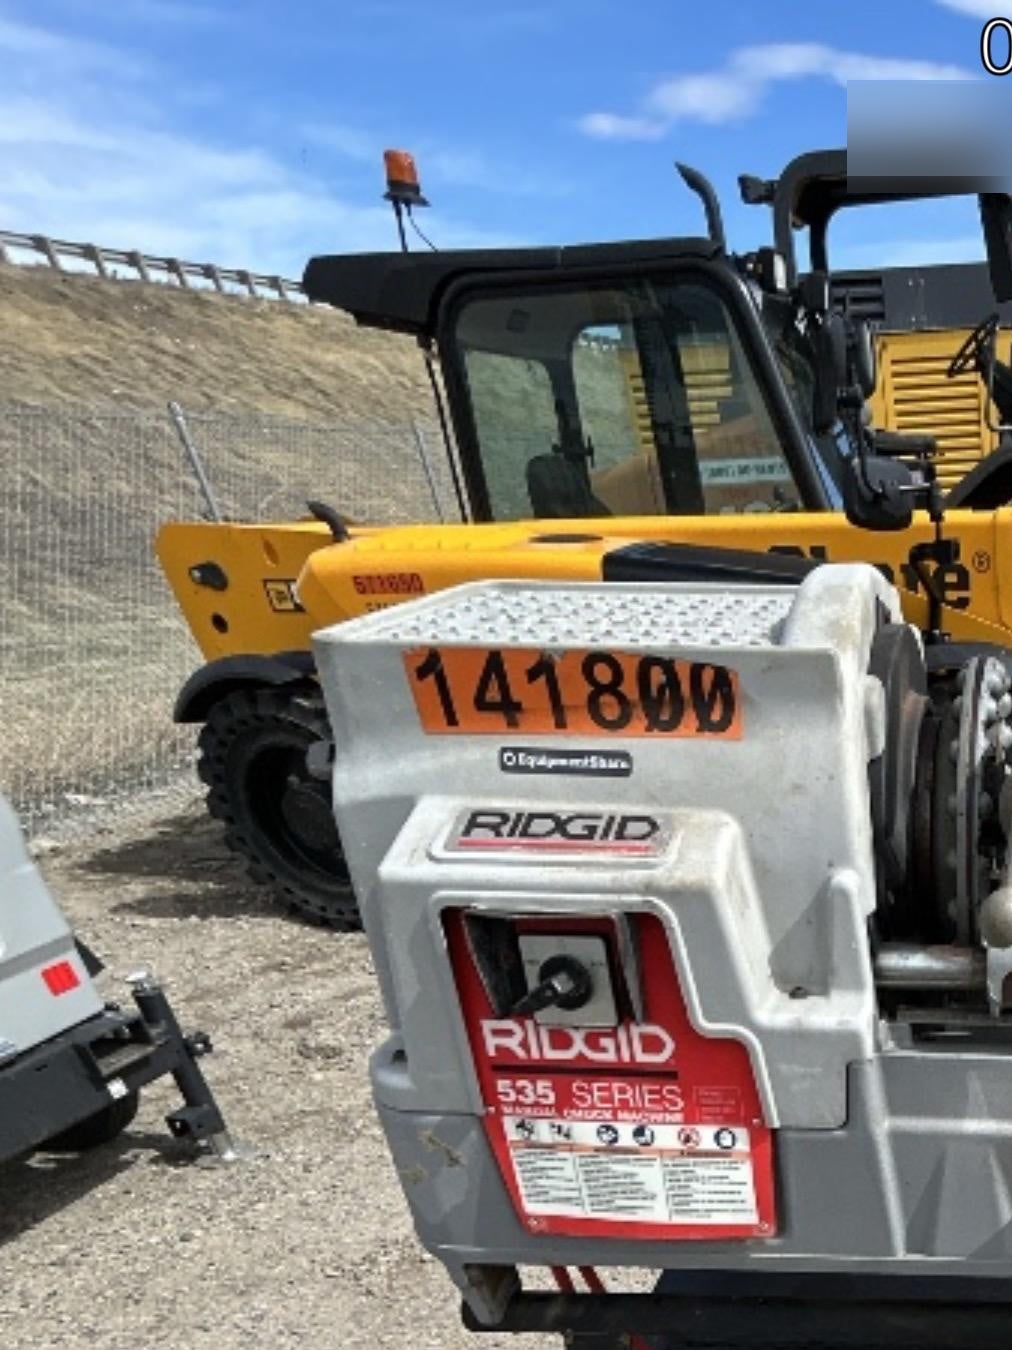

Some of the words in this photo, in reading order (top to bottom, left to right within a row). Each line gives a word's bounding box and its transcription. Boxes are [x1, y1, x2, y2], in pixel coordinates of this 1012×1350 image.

[416, 649, 736, 733] 141800
[517, 752, 630, 769] EquipmentShare
[461, 812, 660, 841] RIDGID
[480, 1018, 676, 1063] RIDGID
[496, 1079, 556, 1105] 535
[571, 1080, 684, 1111] SERIES
